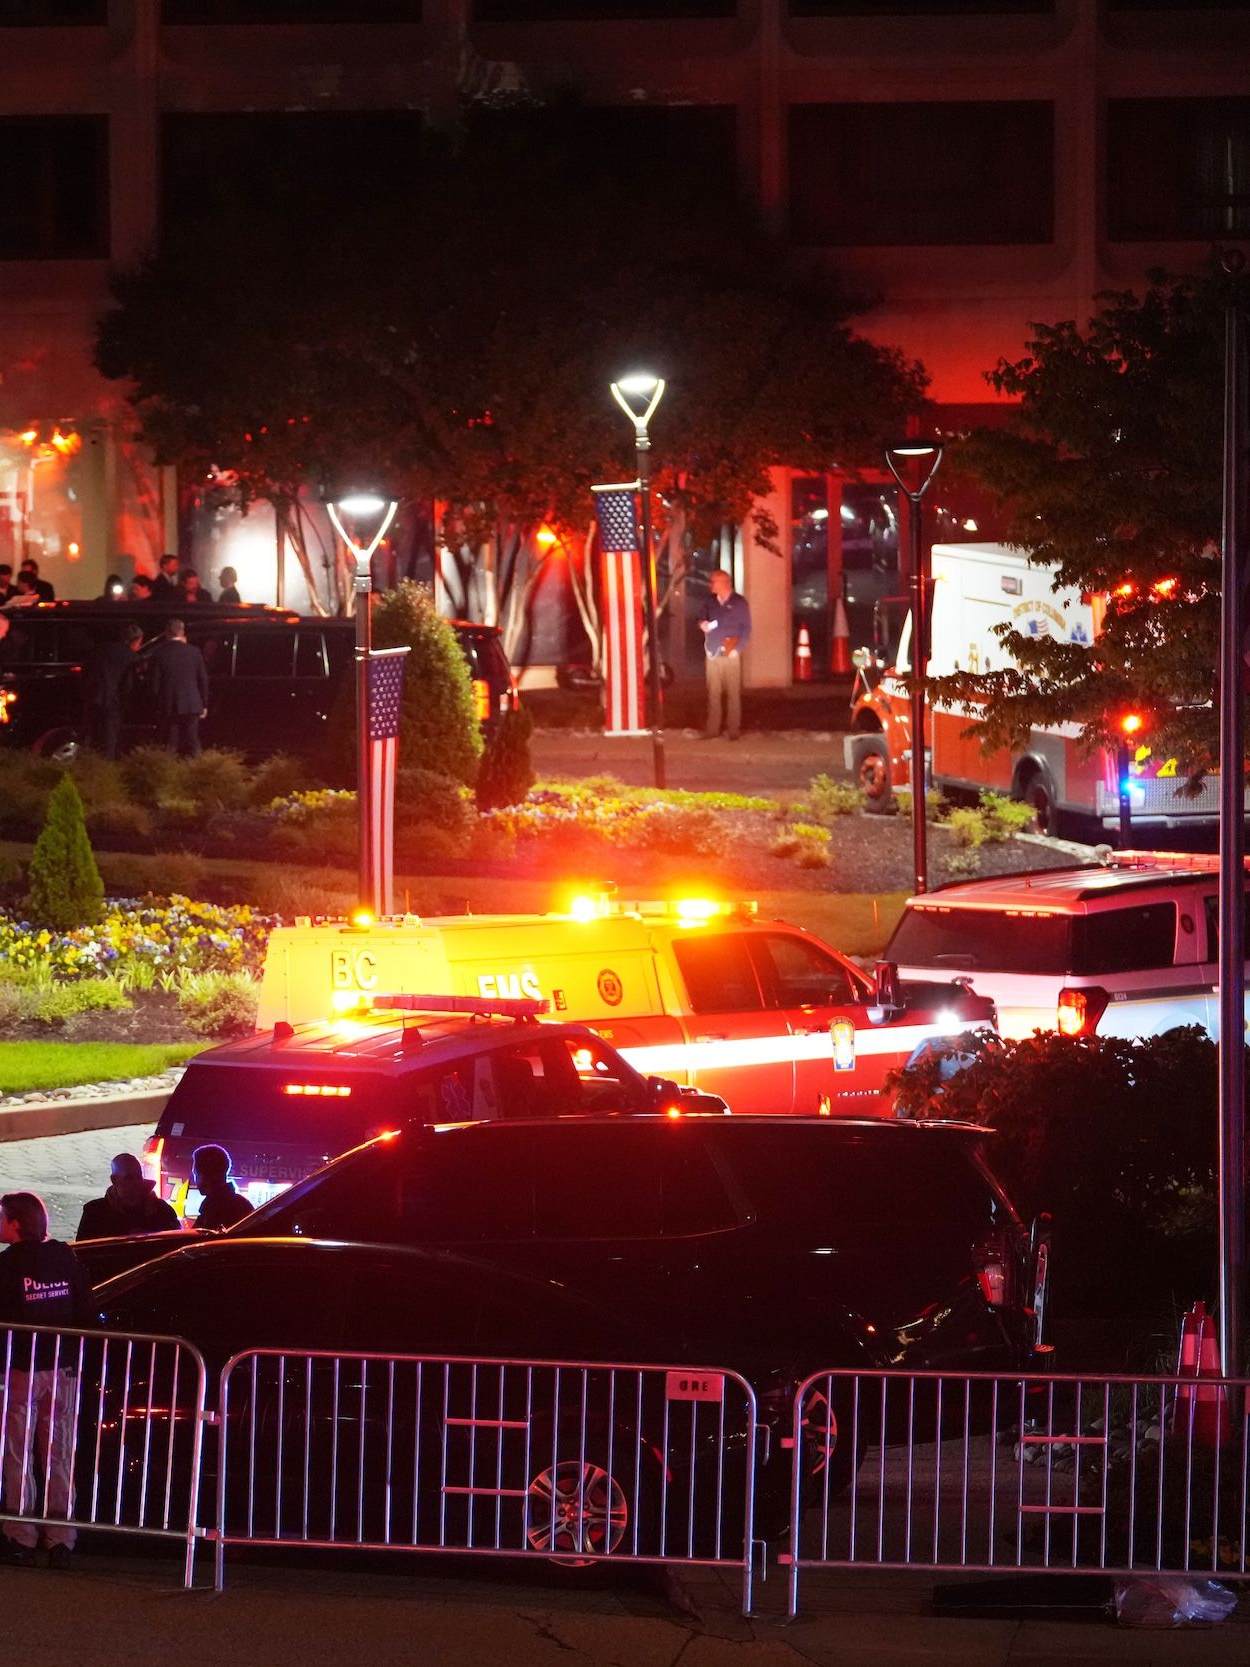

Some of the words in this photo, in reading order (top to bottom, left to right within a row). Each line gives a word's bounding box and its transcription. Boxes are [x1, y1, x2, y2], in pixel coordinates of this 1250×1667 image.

[332, 950, 378, 991] BC
[478, 971, 542, 1000] EMS
[240, 1164, 311, 1179] SUPERVIS
[25, 1291, 47, 1302] SECRET
